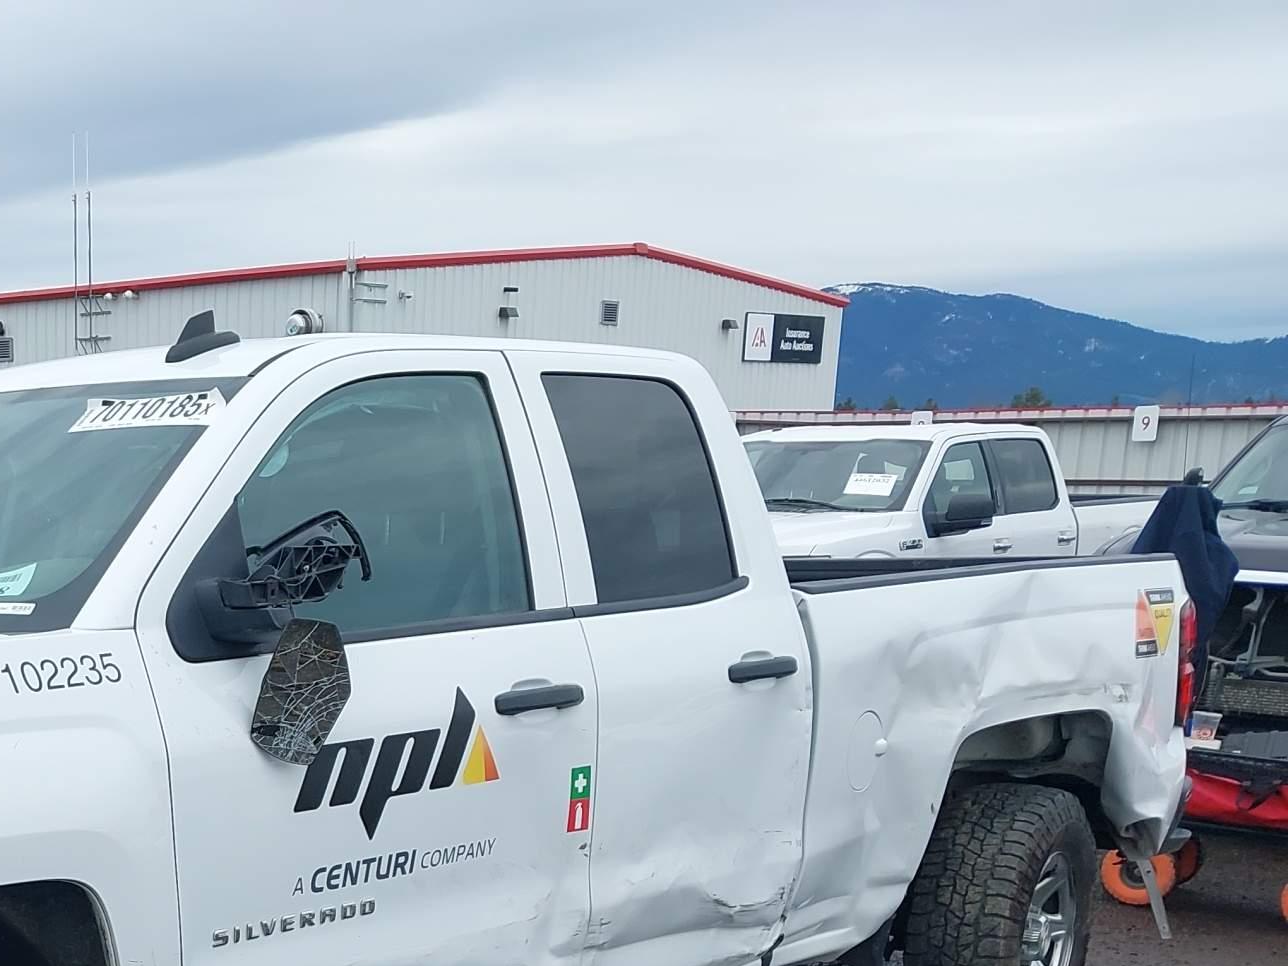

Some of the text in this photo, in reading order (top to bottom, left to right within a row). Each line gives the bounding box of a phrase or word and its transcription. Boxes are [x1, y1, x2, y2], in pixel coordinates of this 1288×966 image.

[780, 339, 814, 352] Auto Auctions
[786, 327, 810, 339] Insurance
[89, 393, 208, 424] 70110185
[1141, 415, 1151, 431] 9
[0, 652, 122, 694] 102235
[293, 685, 476, 841] npl
[292, 837, 497, 897] A CENTURI COMPANY
[211, 898, 376, 948] SILVERADO
